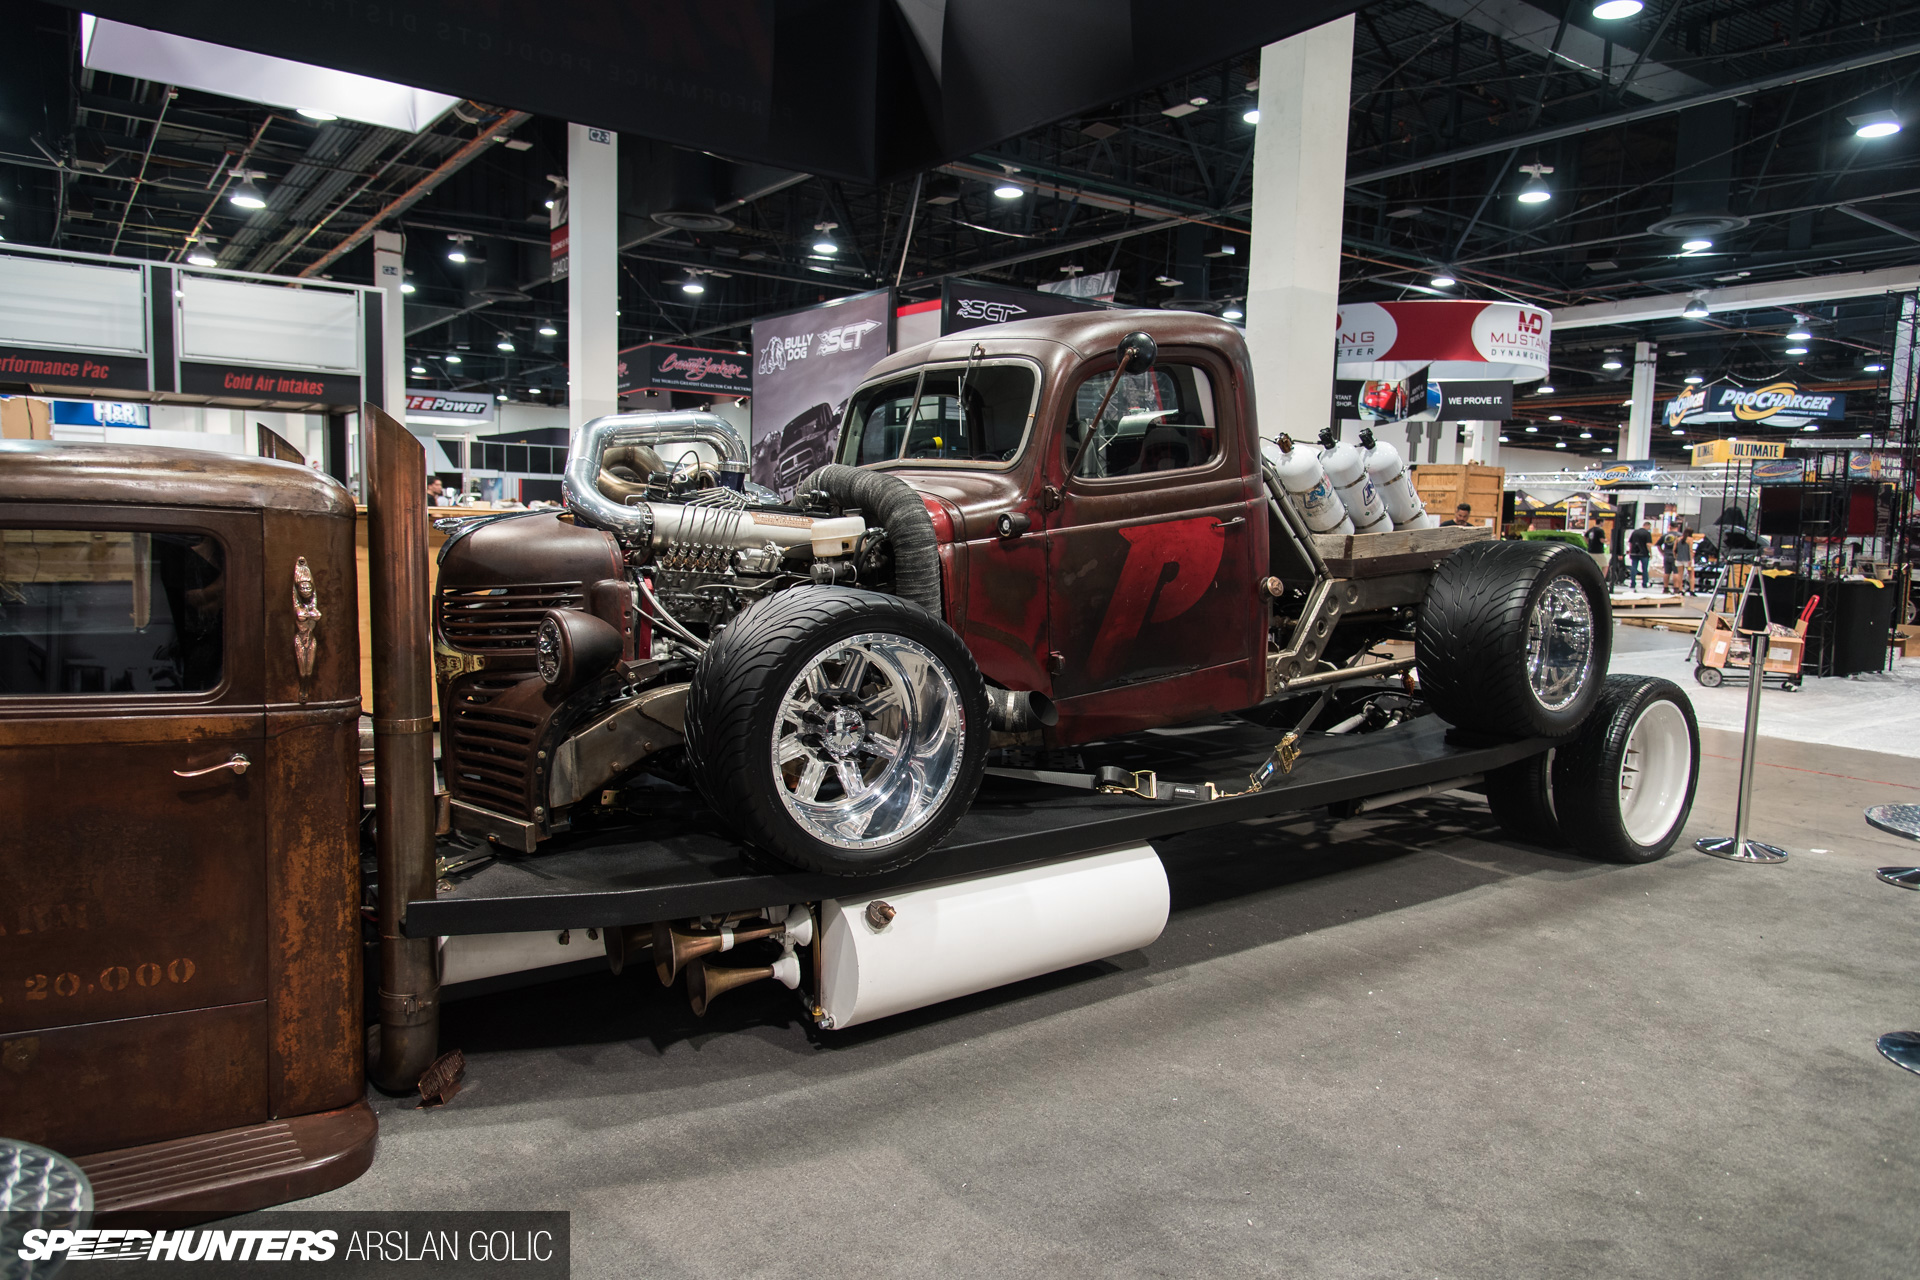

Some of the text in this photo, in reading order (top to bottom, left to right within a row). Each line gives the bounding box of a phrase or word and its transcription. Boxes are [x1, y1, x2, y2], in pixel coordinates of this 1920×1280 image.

[589, 129, 610, 144] C2-3
[1518, 310, 1543, 335] MD
[784, 333, 814, 350] BULLY
[787, 346, 807, 360] DOG
[1491, 348, 1549, 364] DYNAMOMET
[82, 360, 110, 379] Pac
[224, 371, 324, 396] Cold Air Intakes
[1448, 396, 1503, 405] WE PROVE IT.
[94, 402, 137, 423] H&R
[1734, 443, 1779, 458] ULTIMATE
